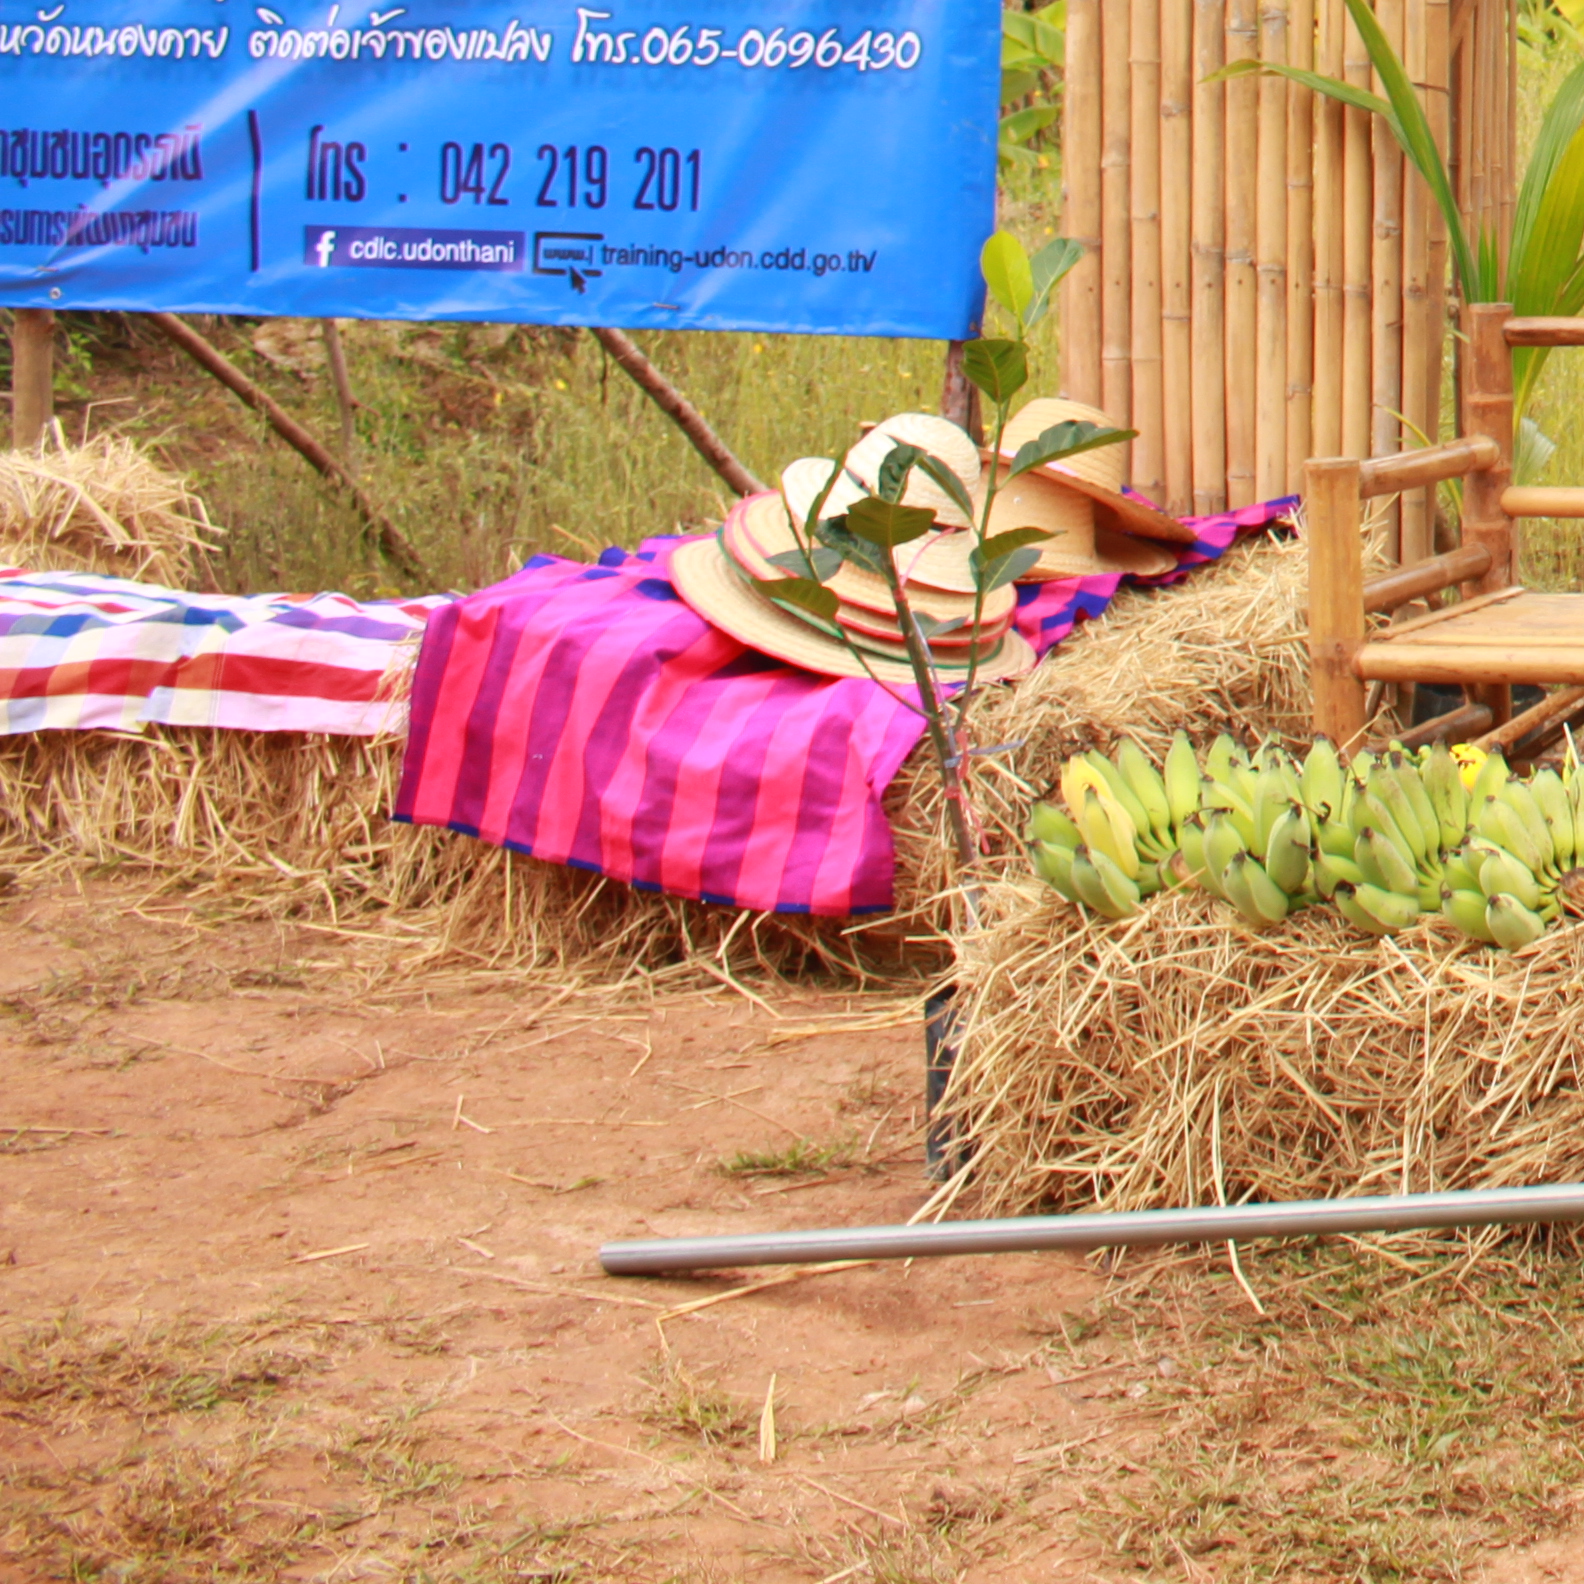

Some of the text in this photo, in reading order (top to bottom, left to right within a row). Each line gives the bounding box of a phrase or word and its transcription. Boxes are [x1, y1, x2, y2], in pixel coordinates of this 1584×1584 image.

[248, 4, 552, 64] ติดต่อเจ้าของแปลง
[305, 124, 367, 202] โทร
[439, 140, 511, 206] 042
[536, 143, 608, 210] 219
[633, 146, 701, 213] 201
[349, 237, 515, 264] cdlc.udonthani
